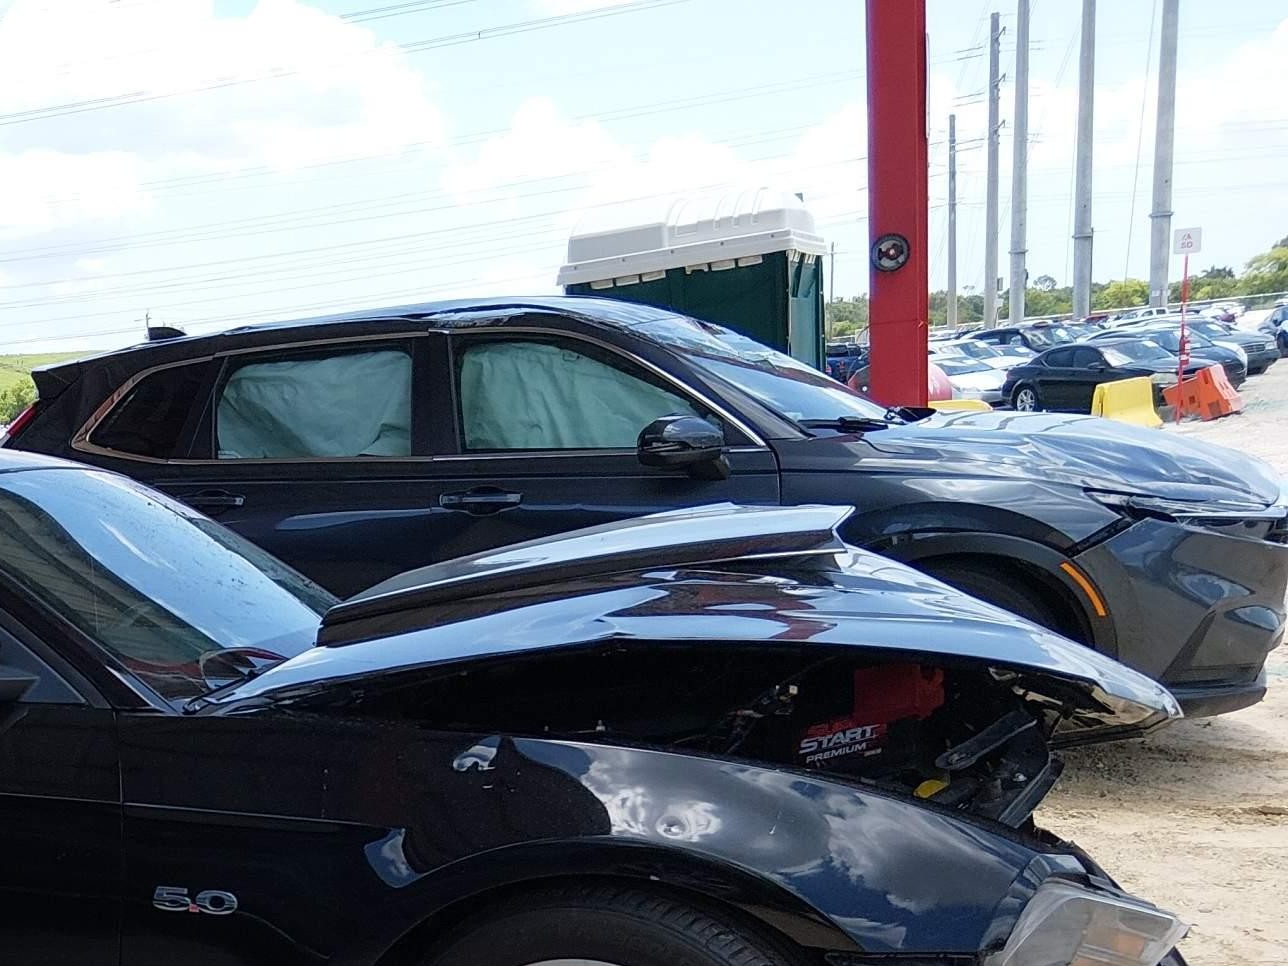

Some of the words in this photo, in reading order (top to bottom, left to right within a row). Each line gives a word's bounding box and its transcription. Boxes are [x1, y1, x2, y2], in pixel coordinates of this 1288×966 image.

[799, 723, 881, 754] START
[805, 741, 867, 764] PREMIUM
[152, 885, 238, 915] 5.0
